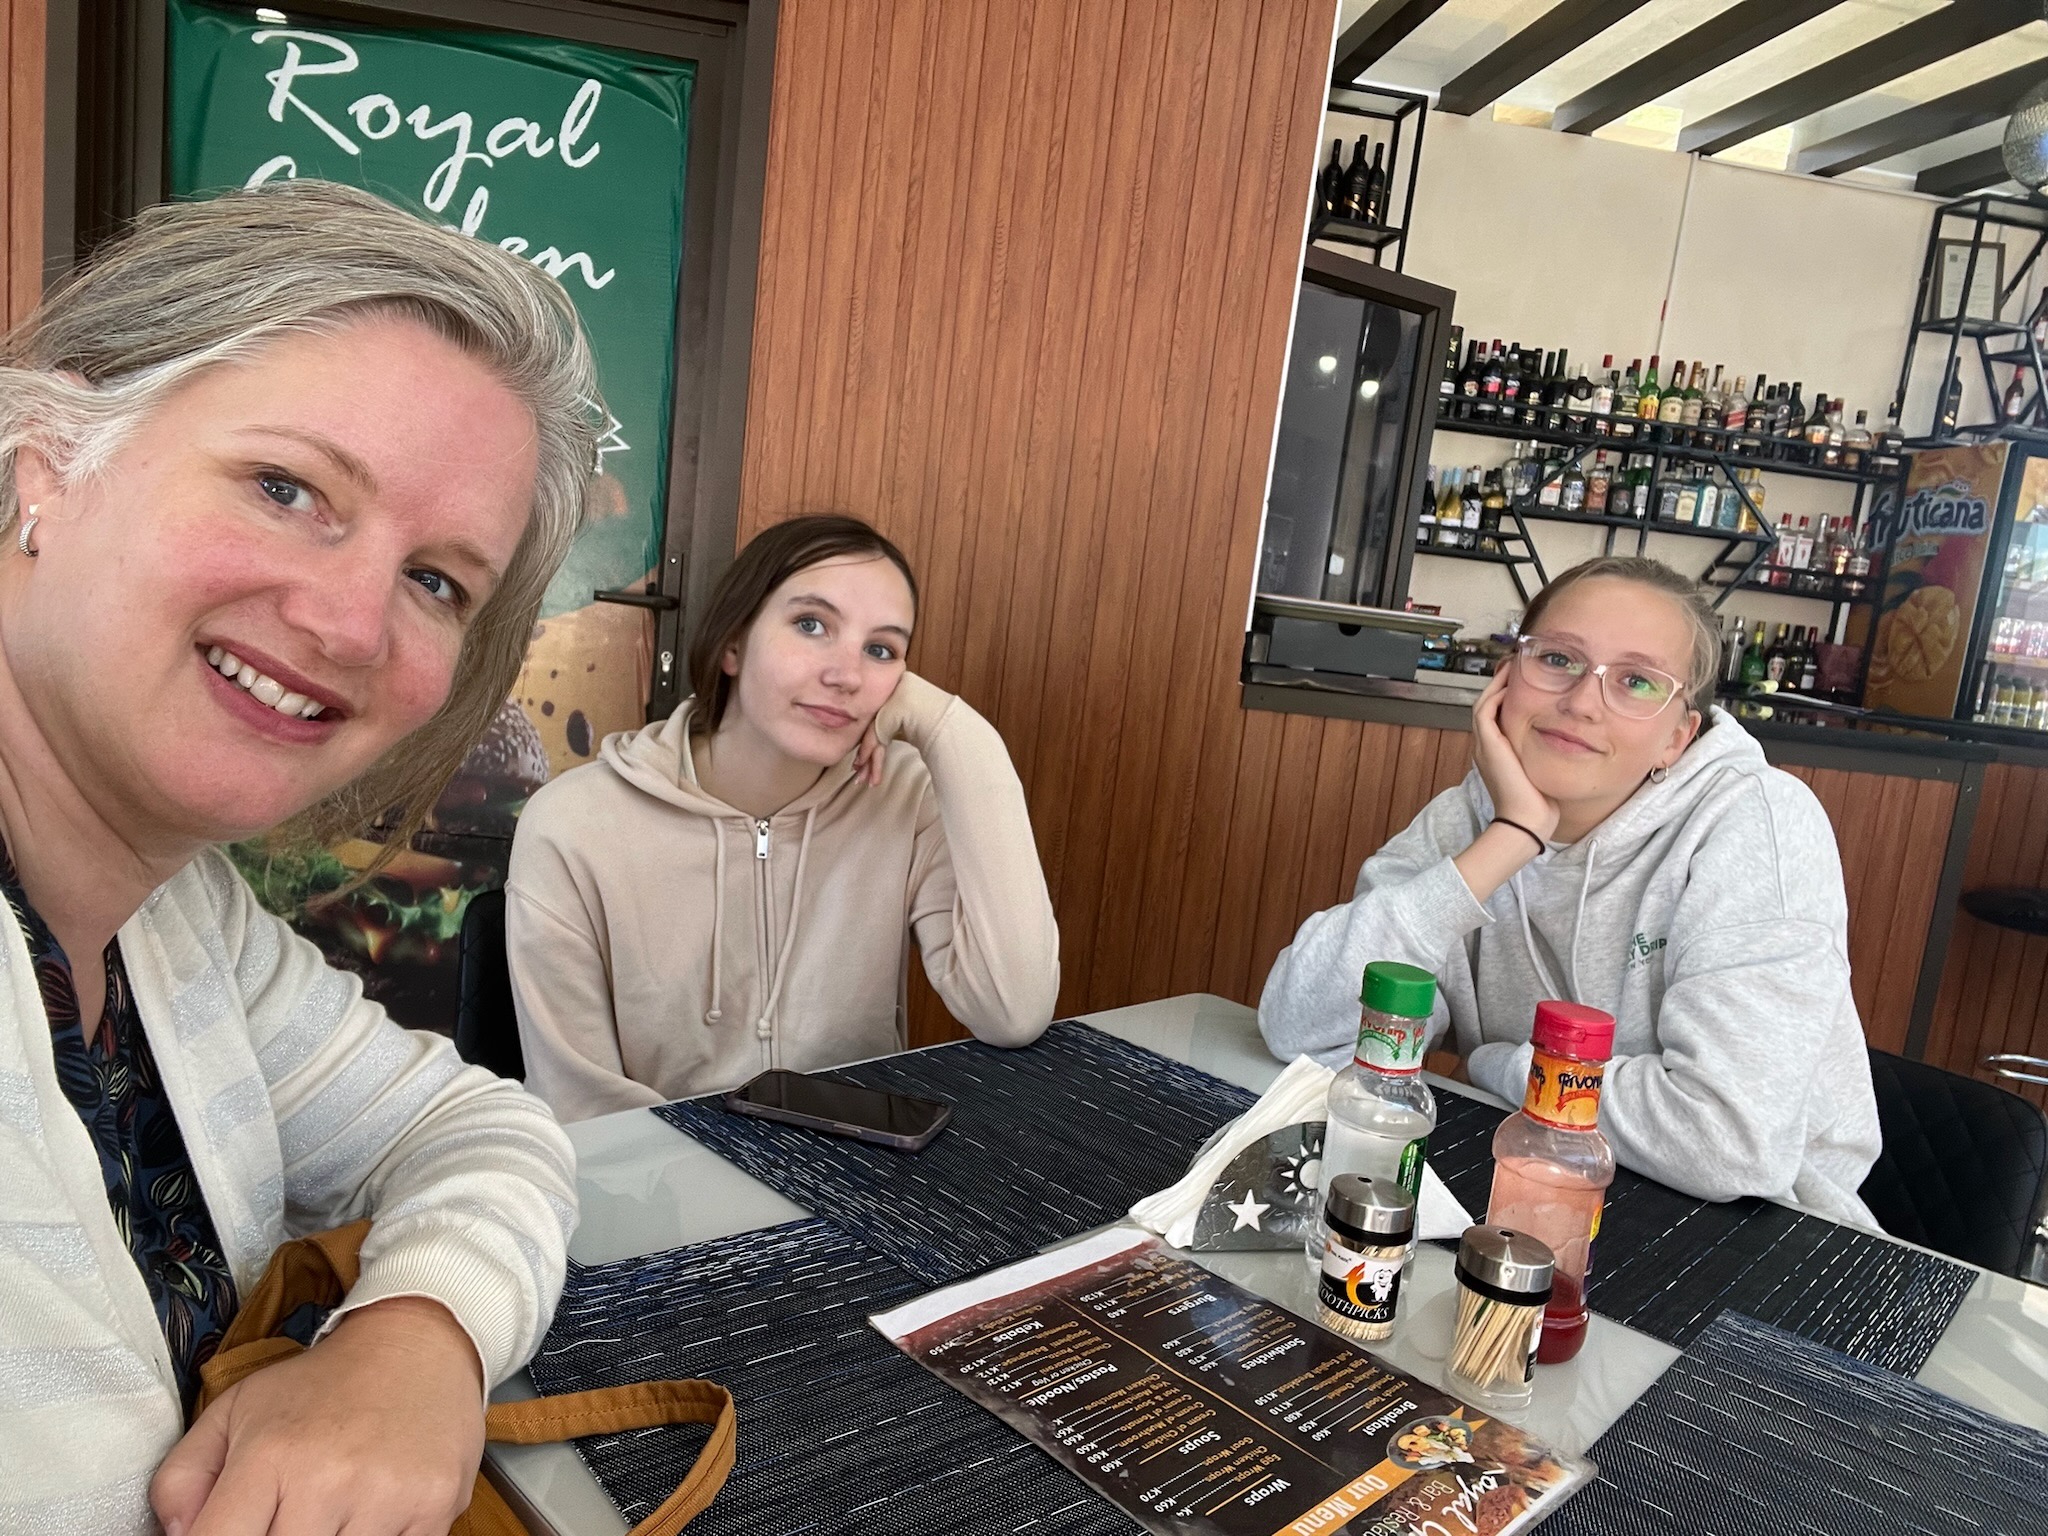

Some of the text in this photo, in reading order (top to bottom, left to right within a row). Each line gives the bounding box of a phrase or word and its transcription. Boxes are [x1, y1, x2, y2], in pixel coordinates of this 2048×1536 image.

[251, 28, 602, 214] Royal
[1092, 1297, 1118, 1311] K110
[1167, 1293, 1218, 1315] Burgers
[992, 1320, 1044, 1343] Kebabs
[1071, 1335, 1102, 1349] Italian
[974, 1328, 1091, 1378] Spaghetti Bolognese K12
[1046, 1346, 1074, 1359] Pasta
[1241, 1337, 1305, 1370] Sandwiches
[1348, 1357, 1368, 1368] Egg
[959, 1357, 987, 1373] K120
[998, 1342, 1112, 1392] Cheese Macaroni K12
[1030, 1357, 1092, 1387] Chicken or Veg
[1310, 1357, 1340, 1374] English
[1025, 1363, 1117, 1406] Pastas/Noodle
[1083, 1372, 1160, 1410] Chicken Manchow
[1149, 1380, 1171, 1390] Veg
[1161, 1386, 1181, 1397] Hot
[1275, 1371, 1314, 1393] Breakfast
[1110, 1388, 1153, 1410] Manchow
[1133, 1398, 1156, 1411] Sour
[1254, 1391, 1278, 1406] K150
[1268, 1400, 1293, 1415] K110
[1361, 1395, 1386, 1409] Toast
[1075, 1393, 1192, 1455] Cream of Tomato K60
[1297, 1419, 1318, 1432] K50
[1362, 1400, 1418, 1436] Breakfast
[1062, 1432, 1085, 1446] K60
[1086, 1400, 1204, 1463] Cream of Mushroom K60
[1100, 1408, 1216, 1472] Cream of Chicken K60
[1178, 1430, 1221, 1454] Soups
[1311, 1427, 1331, 1441] K60
[1138, 1436, 1254, 1502] Goat Wraps K70
[1153, 1444, 1268, 1512] Chicken Wraps K60
[1175, 1453, 1281, 1516] Egg Wraps K4
[1243, 1478, 1291, 1506] Wraps
[1419, 1479, 1455, 1501] Bar
[1292, 1473, 1388, 1536] Our Menu
[1409, 1495, 1426, 1511] &
